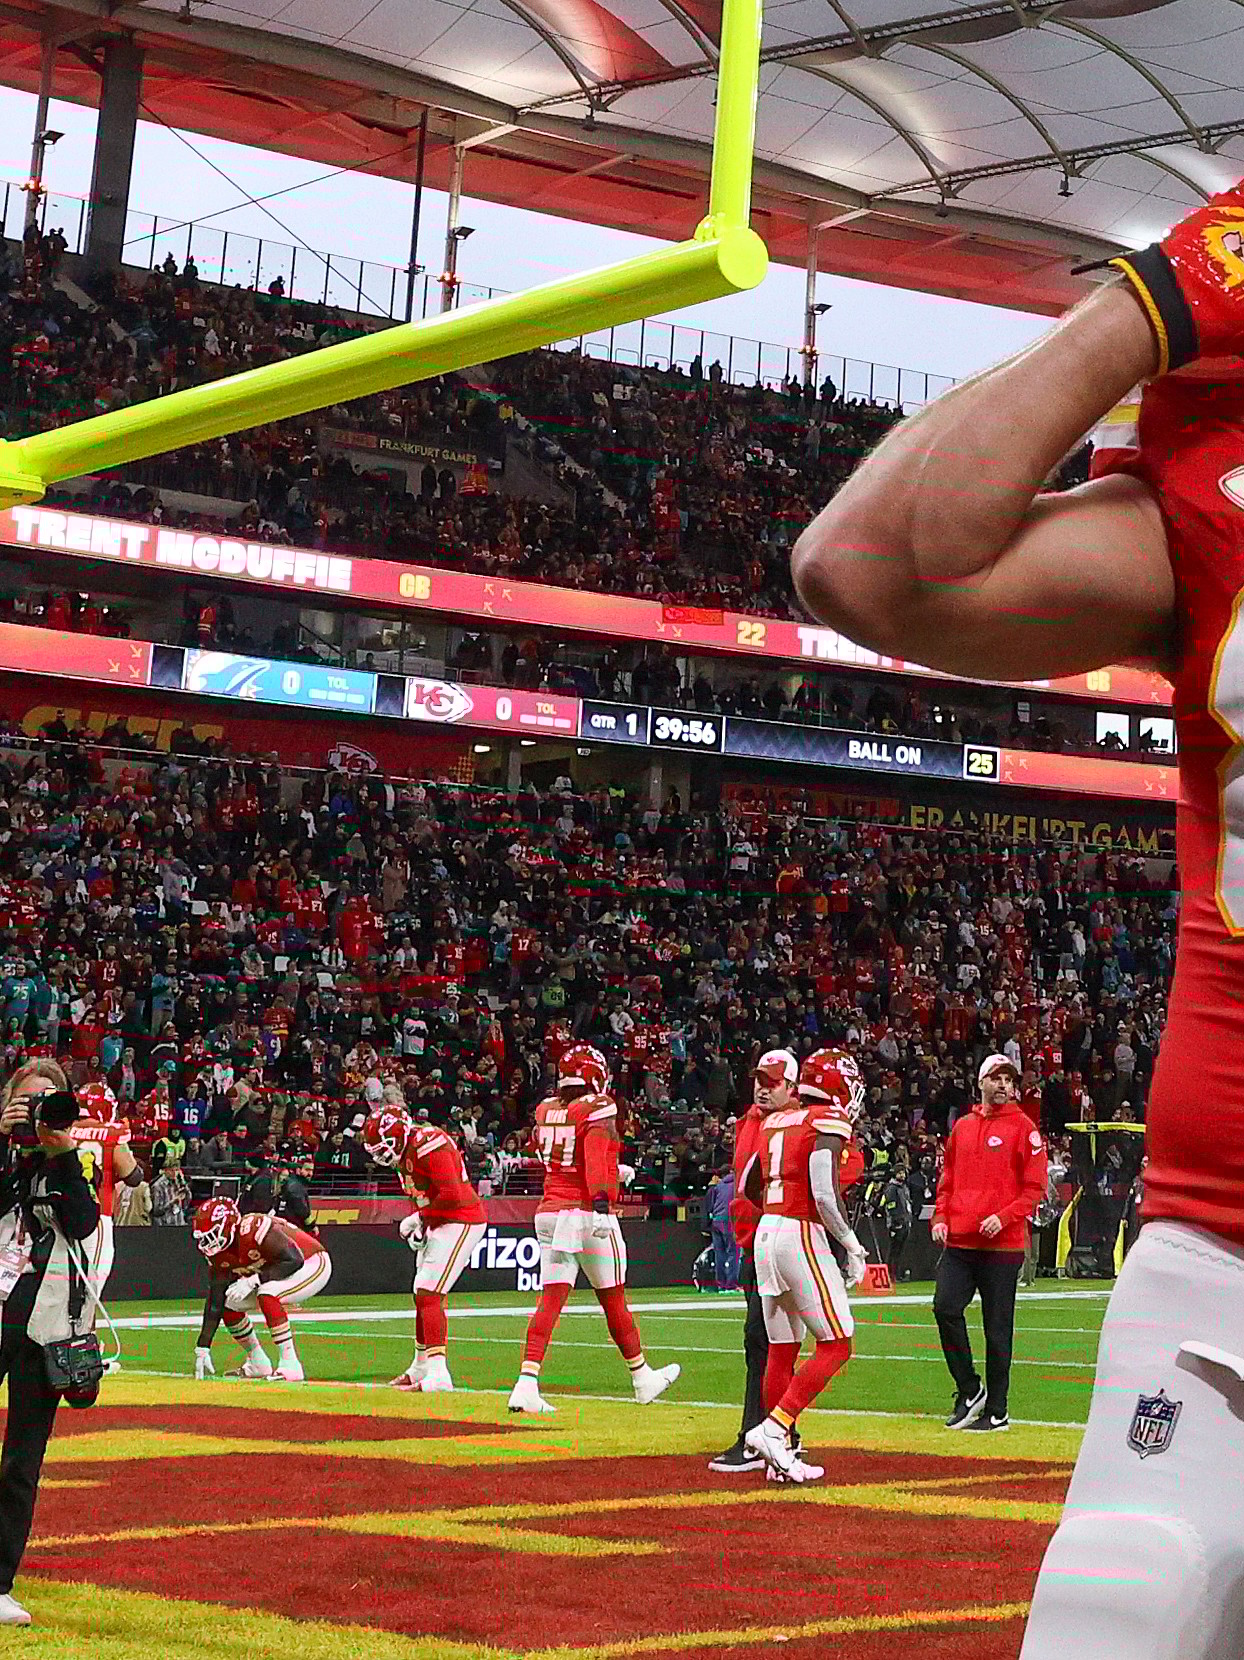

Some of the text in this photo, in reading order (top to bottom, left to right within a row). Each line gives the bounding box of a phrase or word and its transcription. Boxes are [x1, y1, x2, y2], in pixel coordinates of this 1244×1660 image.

[380, 438, 440, 459] FRANKFURT
[442, 449, 478, 464] GAMES
[11, 506, 432, 601] TRENT MCDUFFIE CB
[737, 620, 767, 648] 22
[1086, 670, 1111, 692] CB
[282, 671, 301, 695] 0
[326, 675, 350, 691] TOL
[495, 697, 512, 720] 0
[535, 702, 558, 716] TOL
[590, 714, 616, 730] QTR
[625, 713, 638, 736] 1
[654, 716, 717, 745] 39:56
[847, 739, 893, 763] BALL
[894, 745, 922, 766] ON
[968, 752, 994, 776] 25
[1091, 822, 1176, 855] GAM
[183, 1107, 199, 1125] 16
[538, 1125, 577, 1170] 77
[766, 1130, 785, 1205] 1
[517, 1268, 544, 1291] bu
[869, 1267, 891, 1289] 20
[1133, 1417, 1165, 1445] NFL
